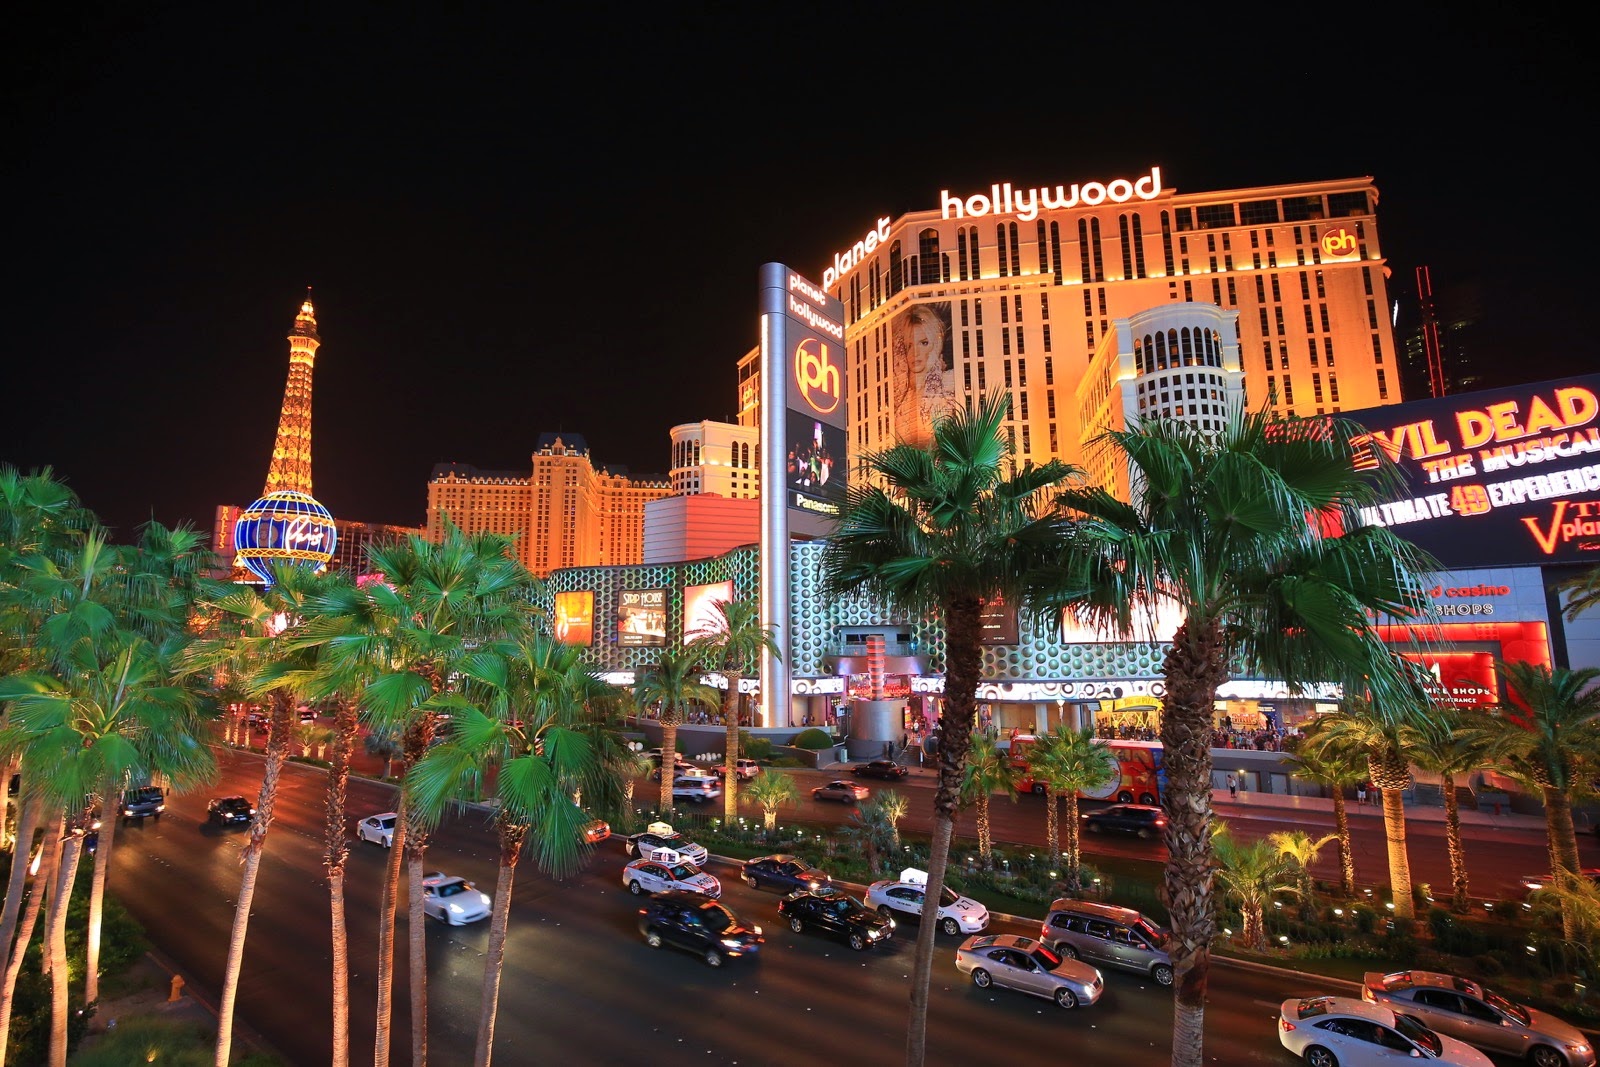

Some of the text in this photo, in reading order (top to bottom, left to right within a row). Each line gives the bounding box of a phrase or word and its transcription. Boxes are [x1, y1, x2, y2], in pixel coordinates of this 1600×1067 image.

[940, 166, 1161, 222] hollywood
[823, 216, 891, 292] planet
[790, 275, 826, 306] planet
[790, 295, 843, 339] hollywood
[1455, 387, 1599, 450] DEAD
[1421, 453, 1477, 484] THE
[1451, 485, 1492, 516] 4D
[1445, 583, 1511, 598] casino
[956, 900, 974, 910] 27
